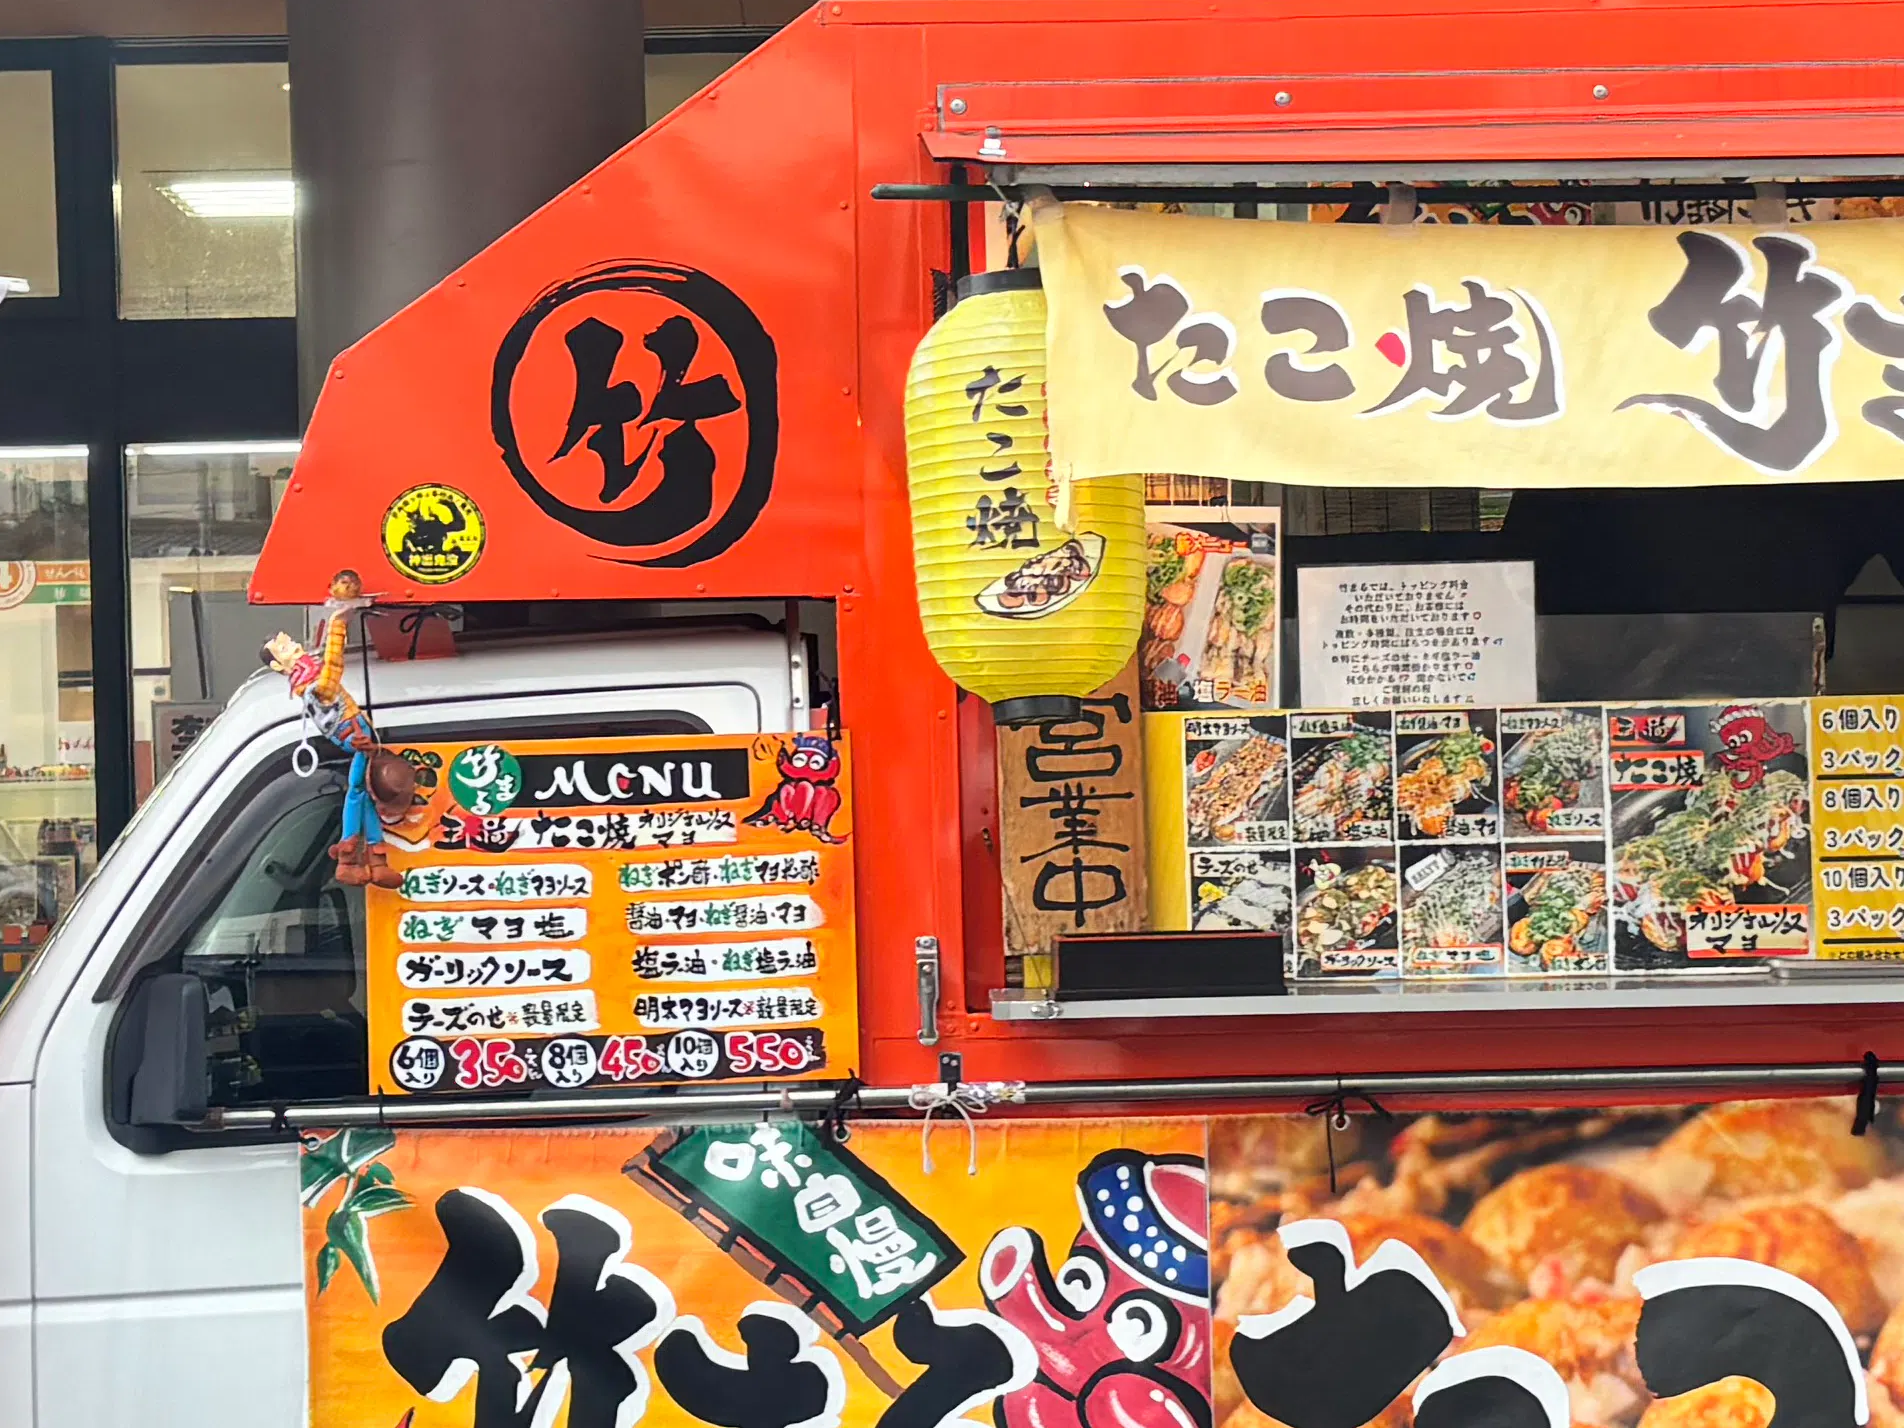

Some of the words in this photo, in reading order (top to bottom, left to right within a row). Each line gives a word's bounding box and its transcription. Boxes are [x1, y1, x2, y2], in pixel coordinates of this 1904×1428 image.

[1102, 264, 1564, 429] たこ焼
[532, 302, 754, 554] 竹
[965, 364, 1041, 552] たこ焼
[1821, 708, 1898, 731] 6個入り
[1614, 753, 1704, 787] たこ焼
[1823, 747, 1902, 769] 3パック
[1824, 787, 1902, 810] 8個入り
[530, 809, 637, 851] たこ焼
[652, 831, 697, 849] マヨ
[1826, 827, 1904, 849] 3パック
[1197, 857, 1259, 875] チーズのせ
[1705, 933, 1759, 954] マヨ
[405, 955, 573, 986] ガーリックソース
[448, 1035, 527, 1089] 350
[598, 1034, 666, 1082] 450
[723, 1030, 807, 1073] 550
[700, 1123, 940, 1301] 味自慢
